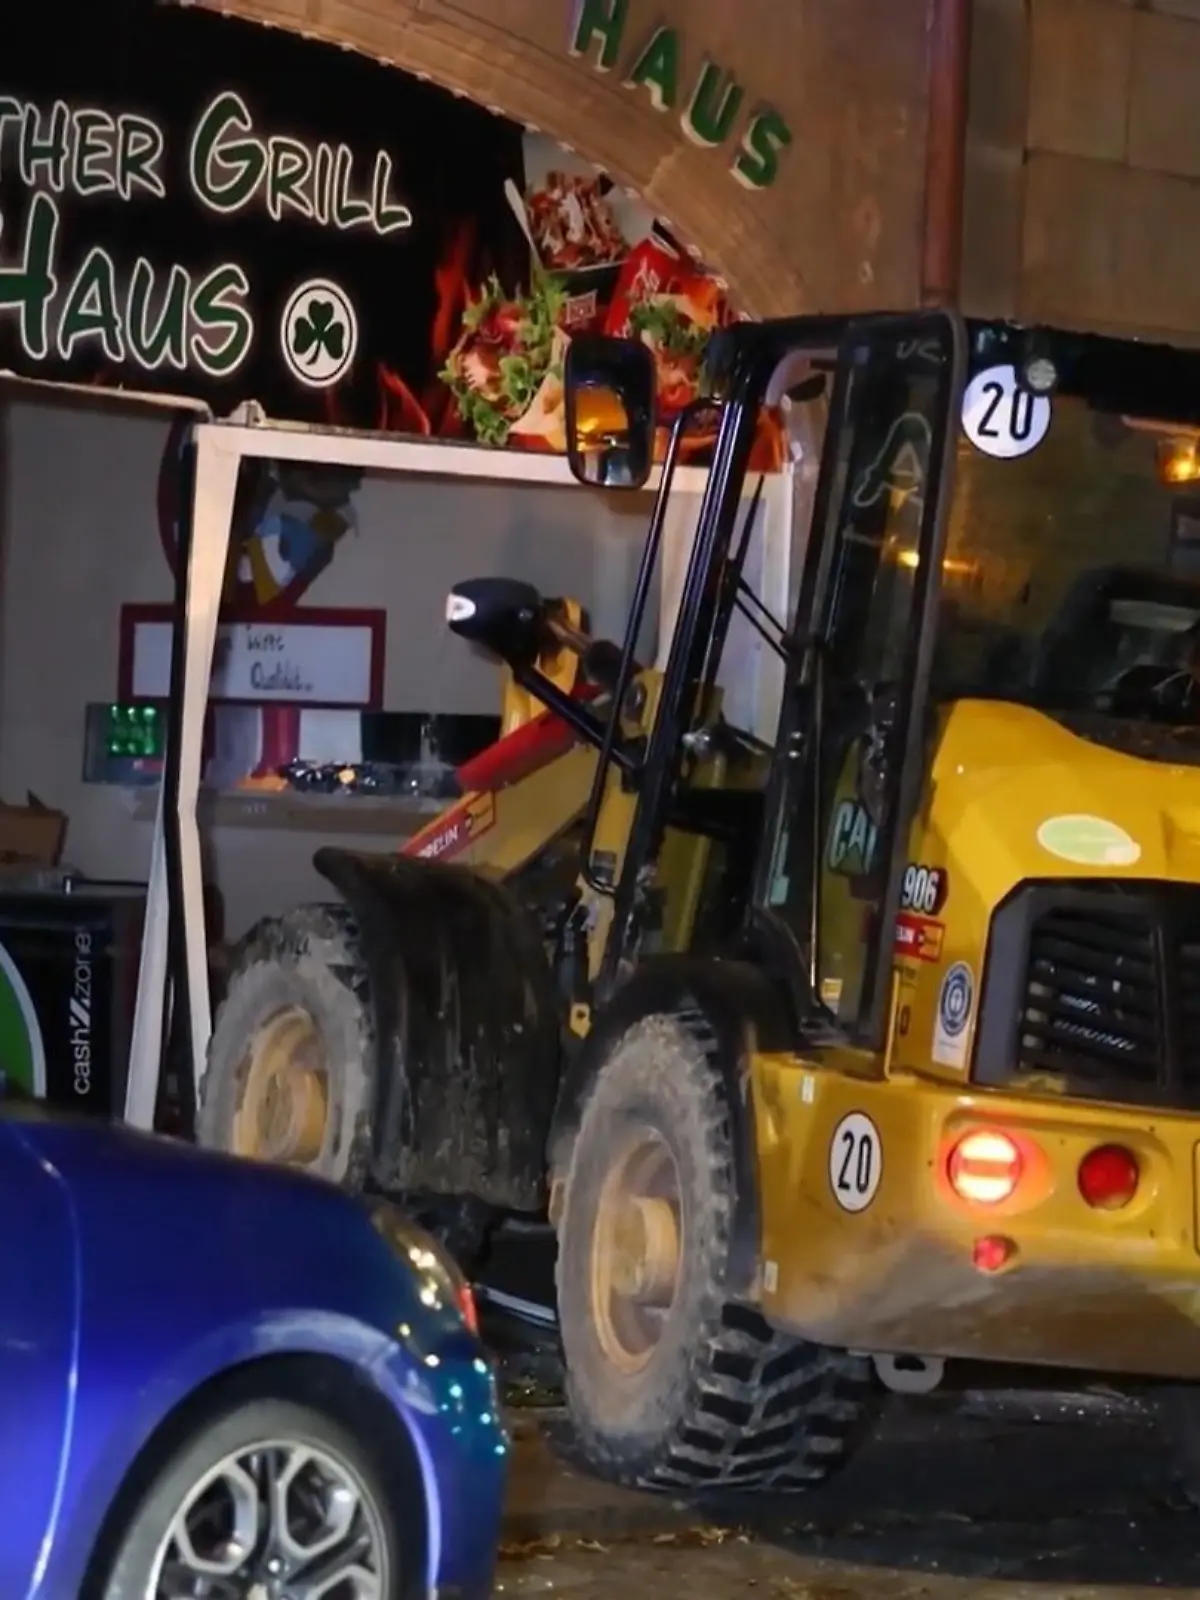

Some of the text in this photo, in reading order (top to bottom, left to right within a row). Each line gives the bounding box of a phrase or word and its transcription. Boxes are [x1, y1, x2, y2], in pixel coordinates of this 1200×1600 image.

[568, 0, 792, 190] HAUS
[190, 91, 412, 234] GRILL
[0, 191, 253, 375] HAUS
[977, 381, 1036, 441] 20
[902, 865, 940, 912] 906
[838, 1130, 873, 1194] 20
